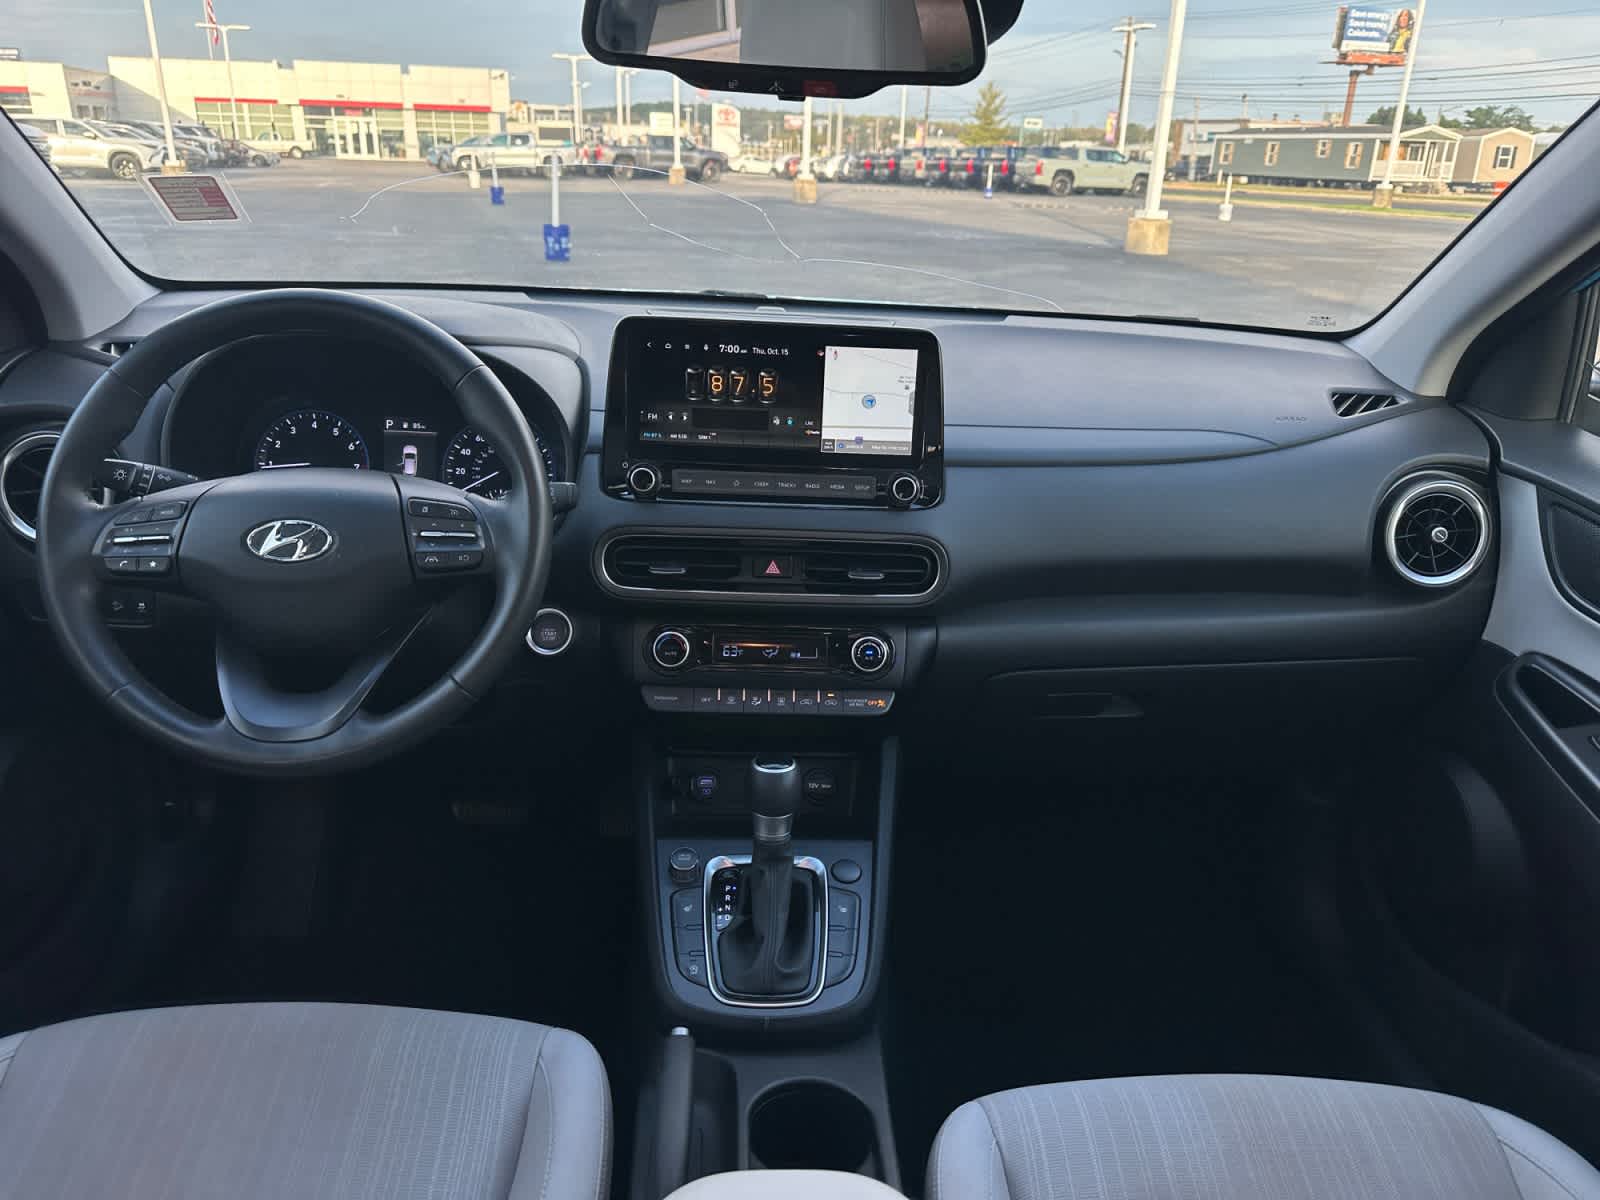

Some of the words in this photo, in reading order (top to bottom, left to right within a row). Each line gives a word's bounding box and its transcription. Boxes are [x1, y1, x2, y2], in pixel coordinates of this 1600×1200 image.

[719, 344, 740, 354] 7:00
[781, 348, 789, 356] 15
[647, 412, 658, 420] FM
[311, 420, 318, 429] 4
[386, 419, 394, 430] P
[290, 426, 297, 434] 3
[333, 427, 340, 436] 5
[275, 440, 281, 449] 2
[348, 442, 355, 451] 6
[460, 448, 471, 456] 40
[455, 467, 466, 475] 20
[725, 894, 731, 902] R
[725, 904, 731, 912] N
